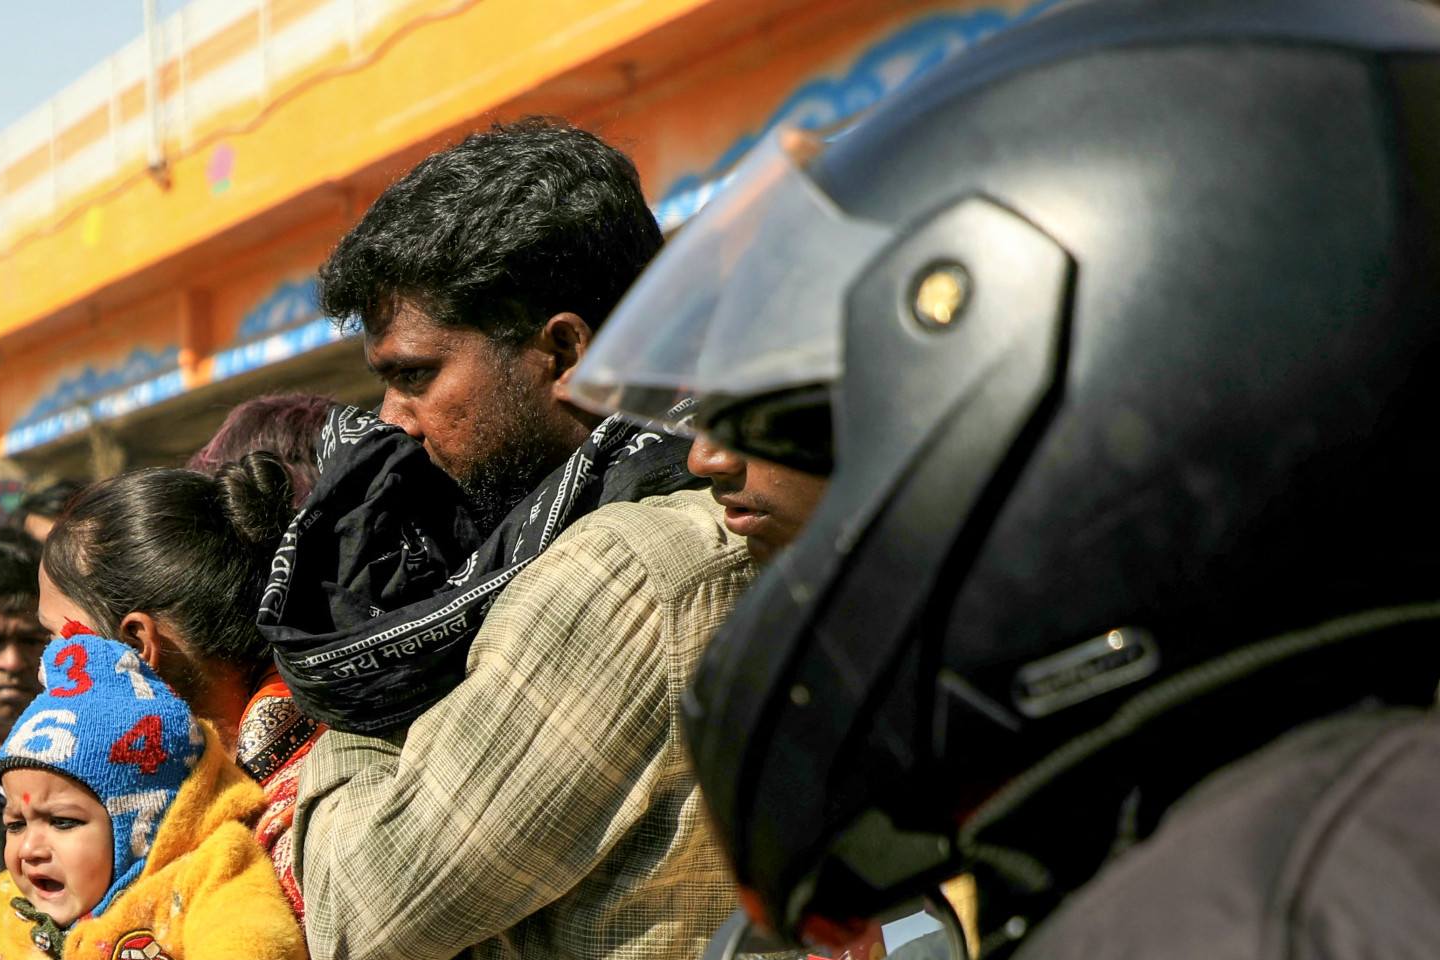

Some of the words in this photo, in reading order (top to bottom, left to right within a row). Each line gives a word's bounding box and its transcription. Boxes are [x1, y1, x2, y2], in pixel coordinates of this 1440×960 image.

[50, 644, 93, 697] 3
[329, 650, 380, 678] जय
[382, 611, 469, 660] महाकाल
[115, 650, 155, 699] 1
[5, 709, 77, 762] 6
[108, 715, 167, 775] 4
[107, 789, 169, 856] 7
